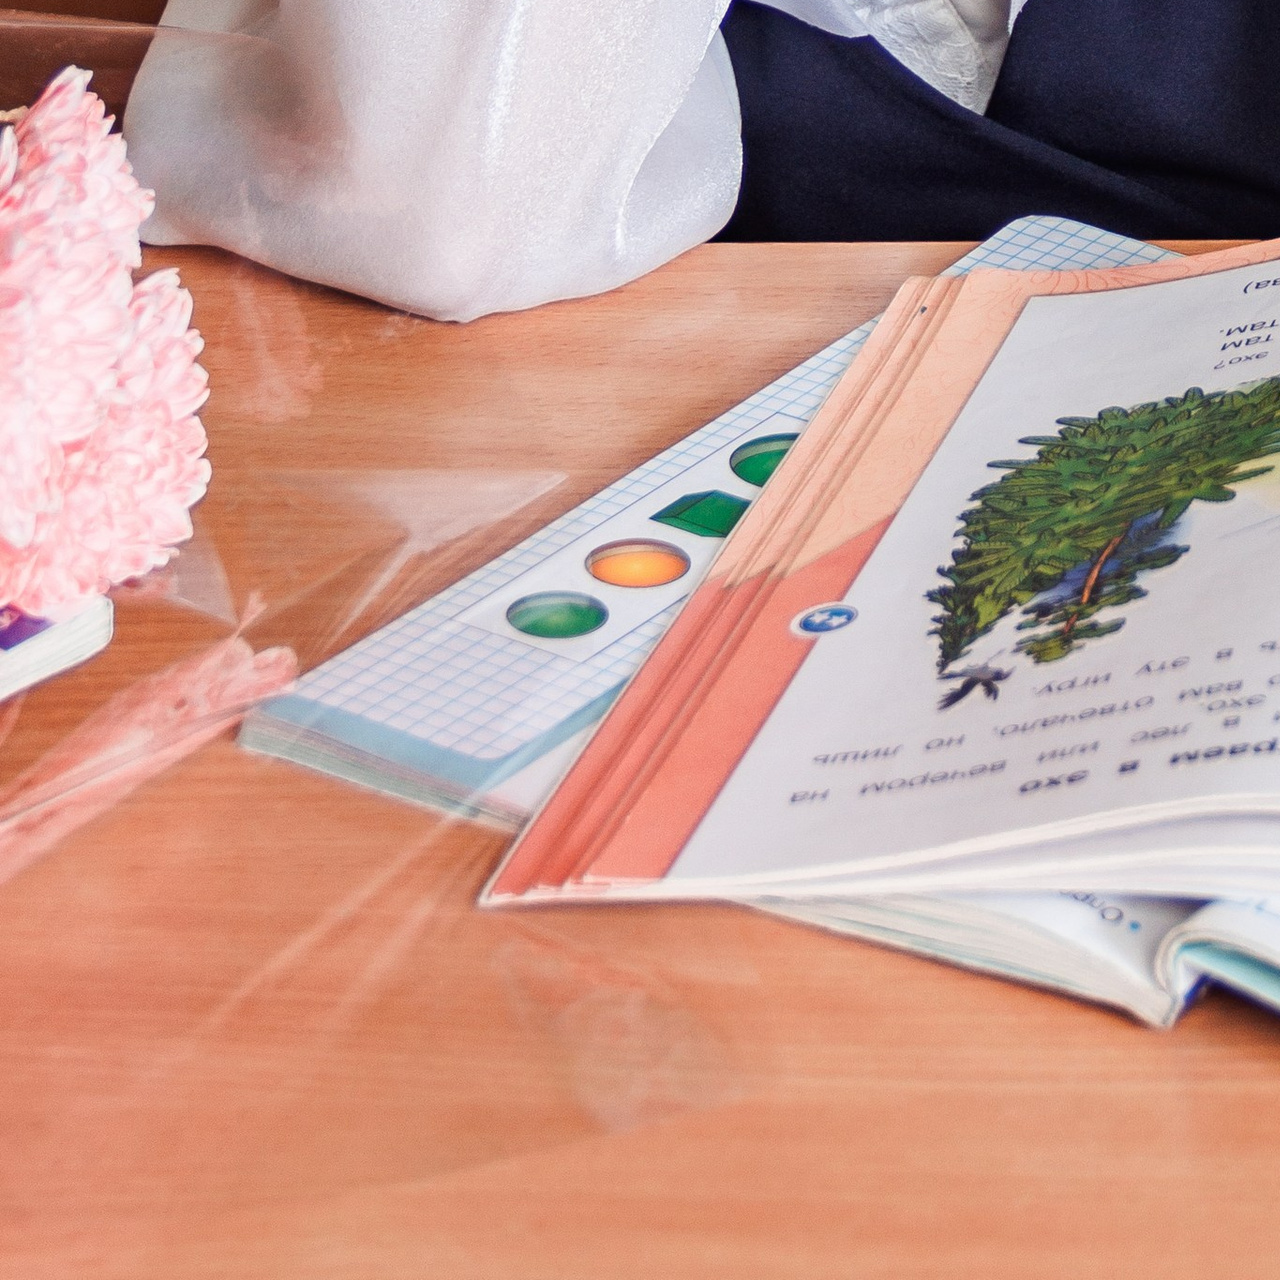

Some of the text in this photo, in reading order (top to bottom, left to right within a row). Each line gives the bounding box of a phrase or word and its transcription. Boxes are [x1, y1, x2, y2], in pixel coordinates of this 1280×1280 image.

[1220, 333, 1272, 352] там
[1212, 350, 1270, 371] эхо?
[1135, 655, 1191, 676] эту
[1035, 672, 1112, 696] игру.
[1177, 680, 1244, 703] вам
[993, 695, 1155, 739] отвечало,
[923, 733, 966, 753] но
[812, 744, 903, 766] лишь
[858, 759, 1008, 797] вечером
[1117, 760, 1140, 775] в
[1018, 769, 1088, 796] эхо
[788, 788, 830, 806] на
